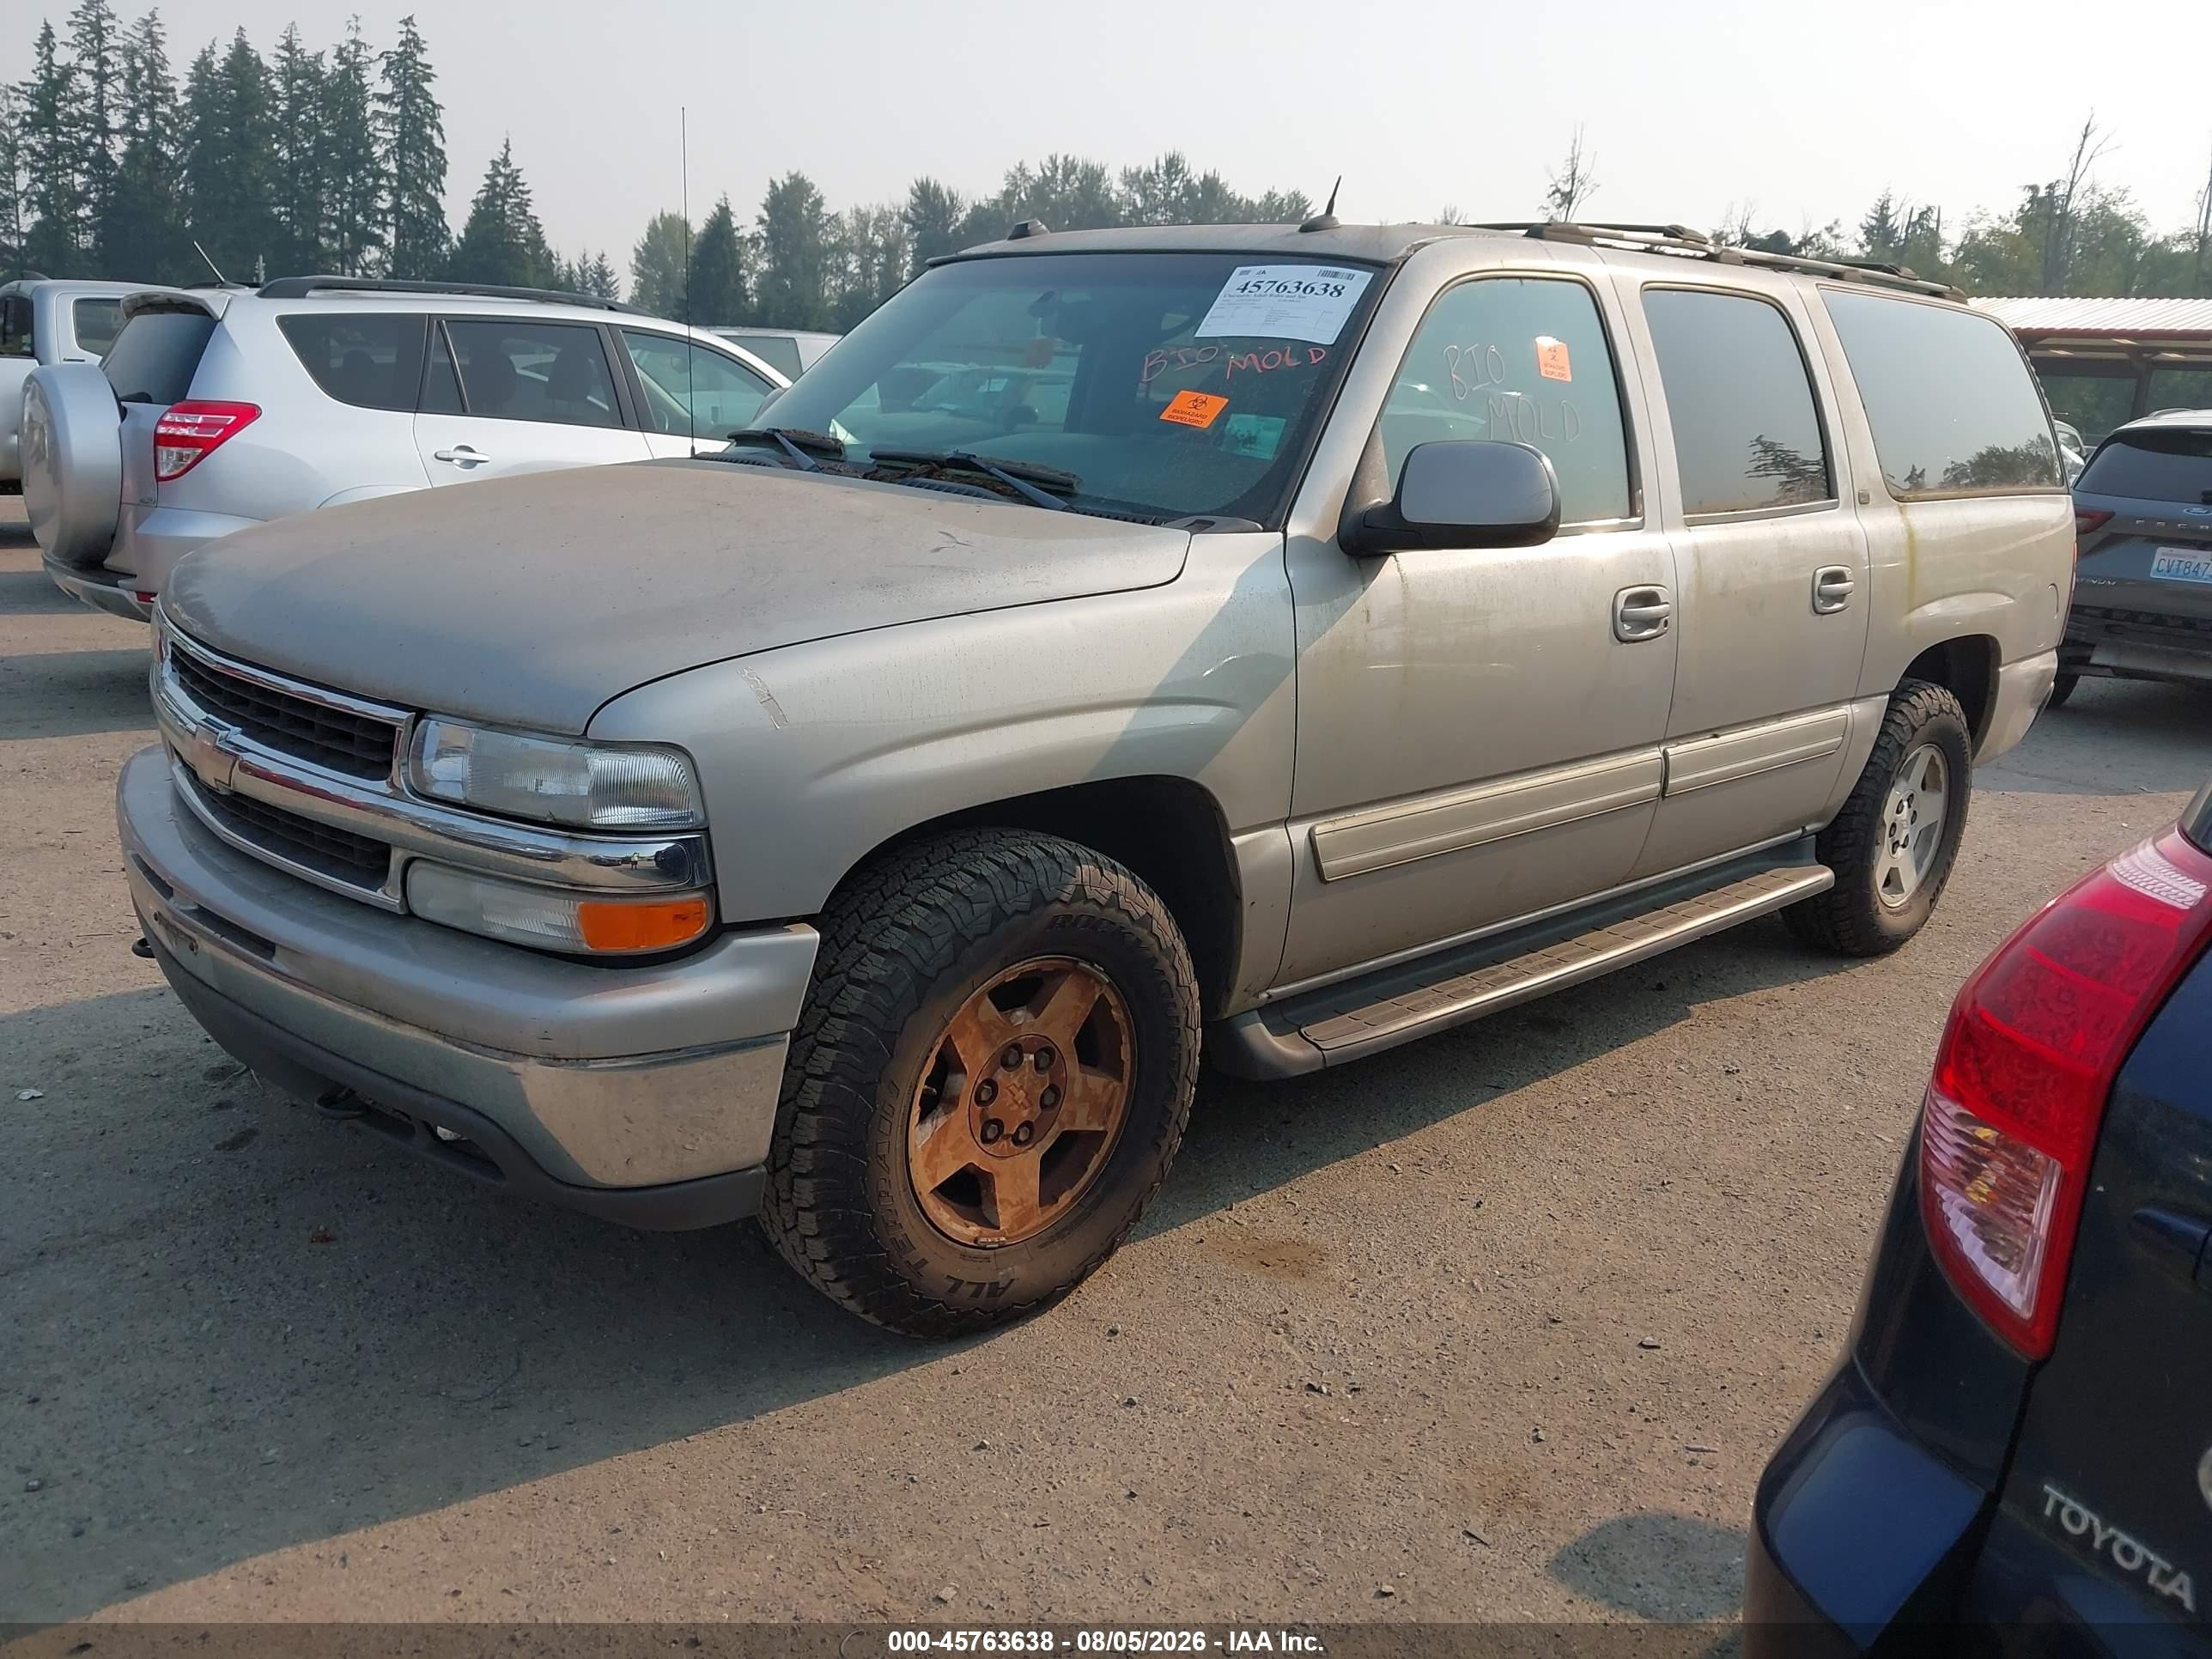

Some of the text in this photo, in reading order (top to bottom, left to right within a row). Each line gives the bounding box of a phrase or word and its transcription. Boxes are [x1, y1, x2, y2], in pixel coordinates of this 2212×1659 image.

[1236, 280, 1346, 299] 45763638
[1141, 345, 1327, 383] BIO MOLD
[1443, 343, 1505, 400] BIO
[1171, 408, 1208, 420] BIOHAZARD
[1487, 396, 1581, 442] MOLD
[2156, 557, 2212, 578] CVT847
[945, 1274, 1017, 1299] ALL
[2042, 1483, 2197, 1613] TOYOTA
